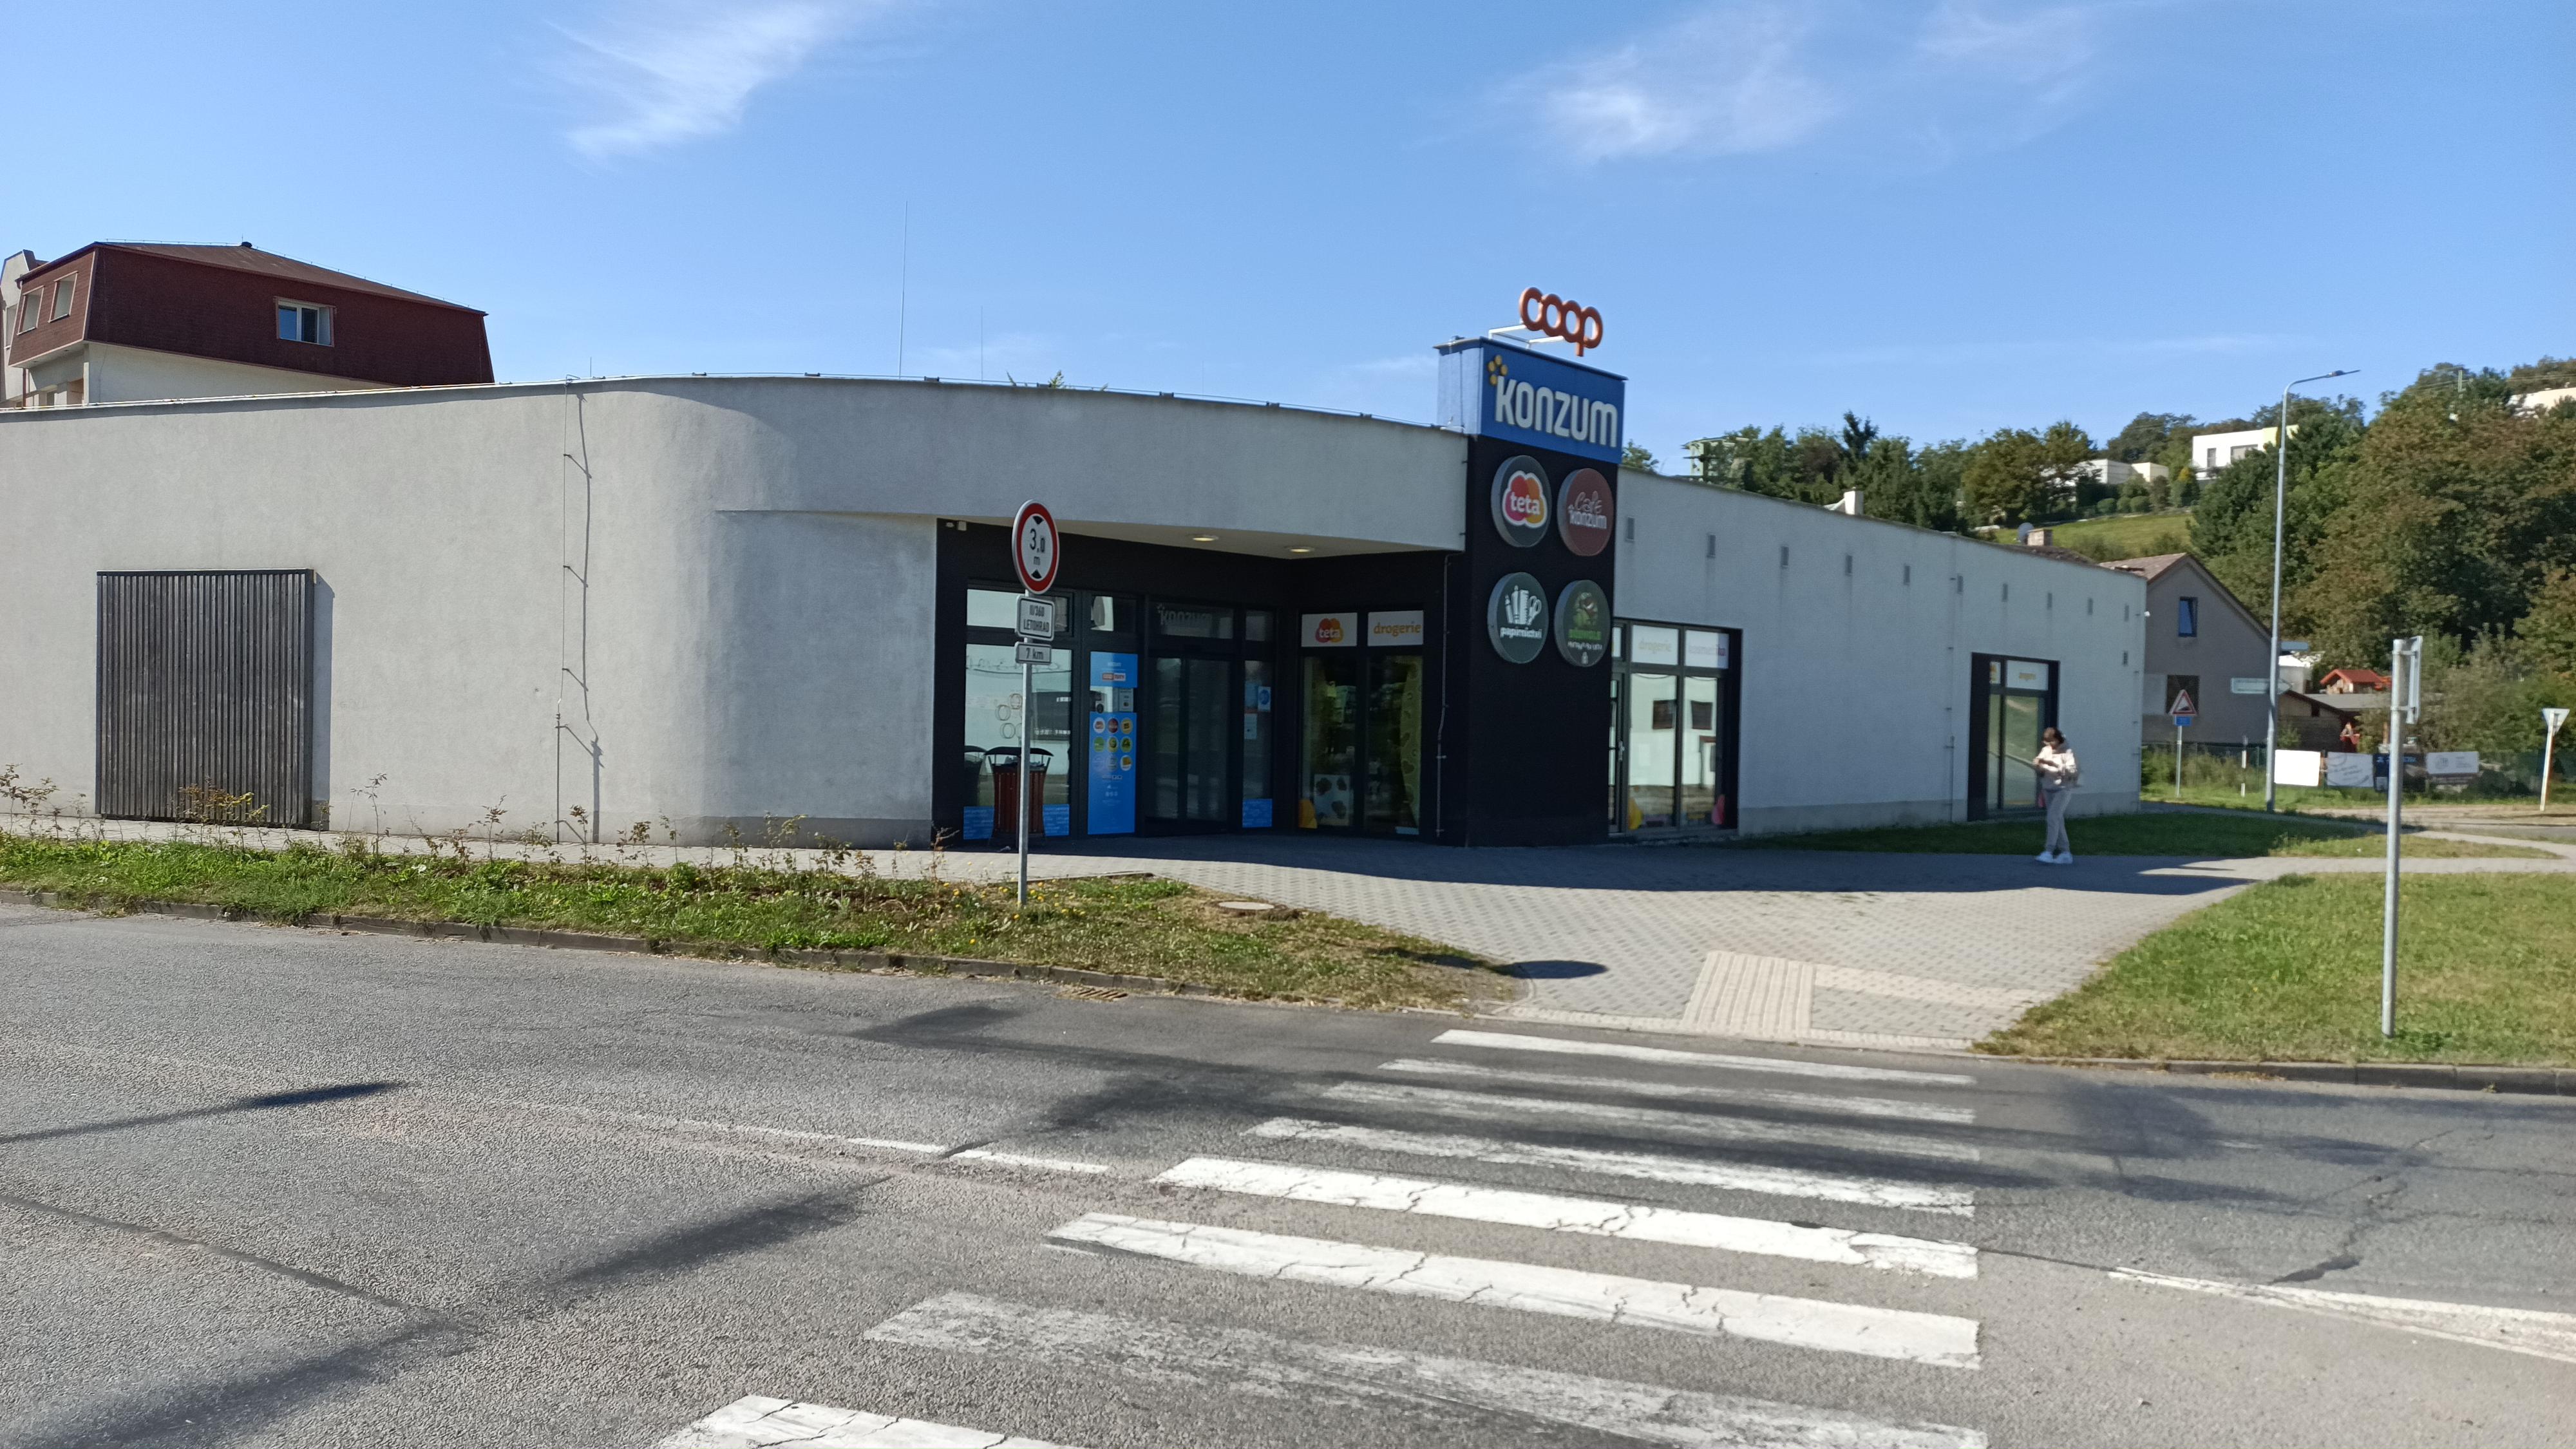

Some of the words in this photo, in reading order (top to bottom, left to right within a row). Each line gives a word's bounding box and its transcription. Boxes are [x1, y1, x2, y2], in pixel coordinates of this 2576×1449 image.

[1519, 287, 1603, 357] coop
[1510, 492, 1540, 515] teta
[1033, 556, 1041, 565] m
[1023, 618, 1050, 632] LETOHRAD
[1373, 621, 1422, 637] drogerie
[1319, 627, 1340, 638] teta
[1026, 647, 1030, 659] 7
[1032, 648, 1043, 659] km
